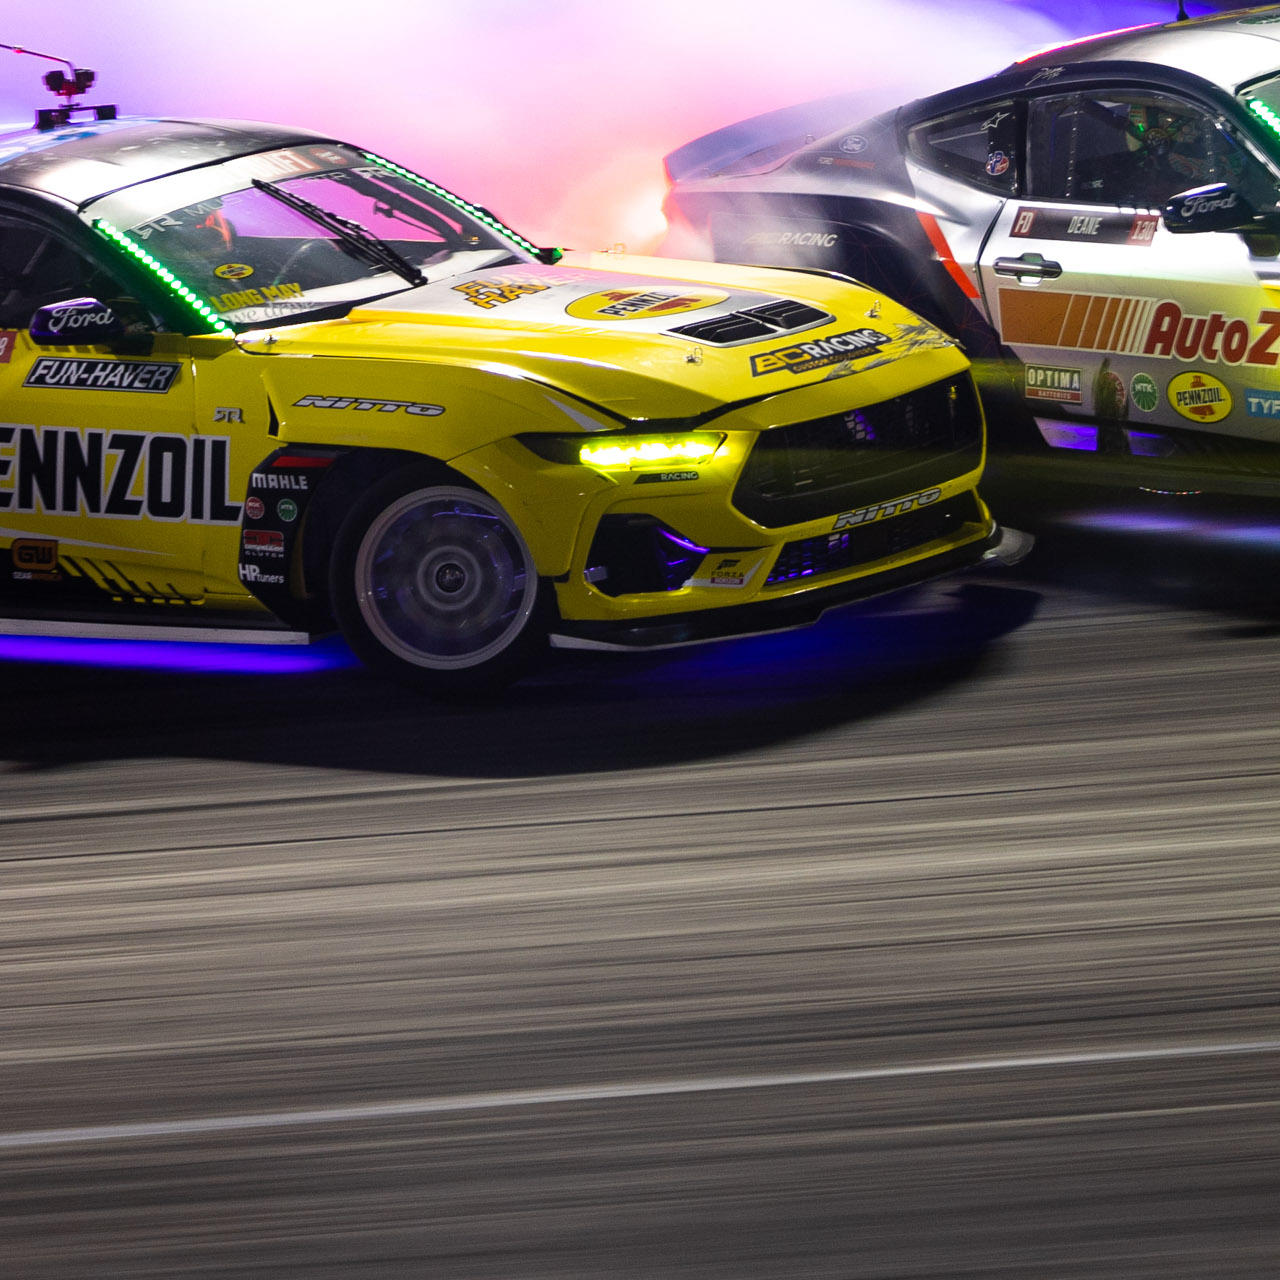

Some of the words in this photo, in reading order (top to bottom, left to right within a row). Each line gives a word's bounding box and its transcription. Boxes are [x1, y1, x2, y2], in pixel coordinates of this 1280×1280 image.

[1181, 191, 1237, 217] Ford
[779, 231, 838, 248] RACING
[1013, 212, 1034, 234] FD
[1067, 215, 1103, 235] DEANE
[1131, 220, 1155, 241] 130
[210, 288, 265, 313] LONG
[260, 282, 305, 302] MAY
[595, 290, 687, 317] PENNZO
[48, 303, 114, 332] Ford
[29, 360, 174, 389] FUN-HAVER
[1027, 368, 1080, 390] OPTIMA
[294, 395, 445, 416] NITTO
[1175, 387, 1225, 406] PENNZOIL
[252, 473, 309, 490] MAHLE
[660, 471, 698, 481] RACING
[833, 488, 942, 530] NITTO
